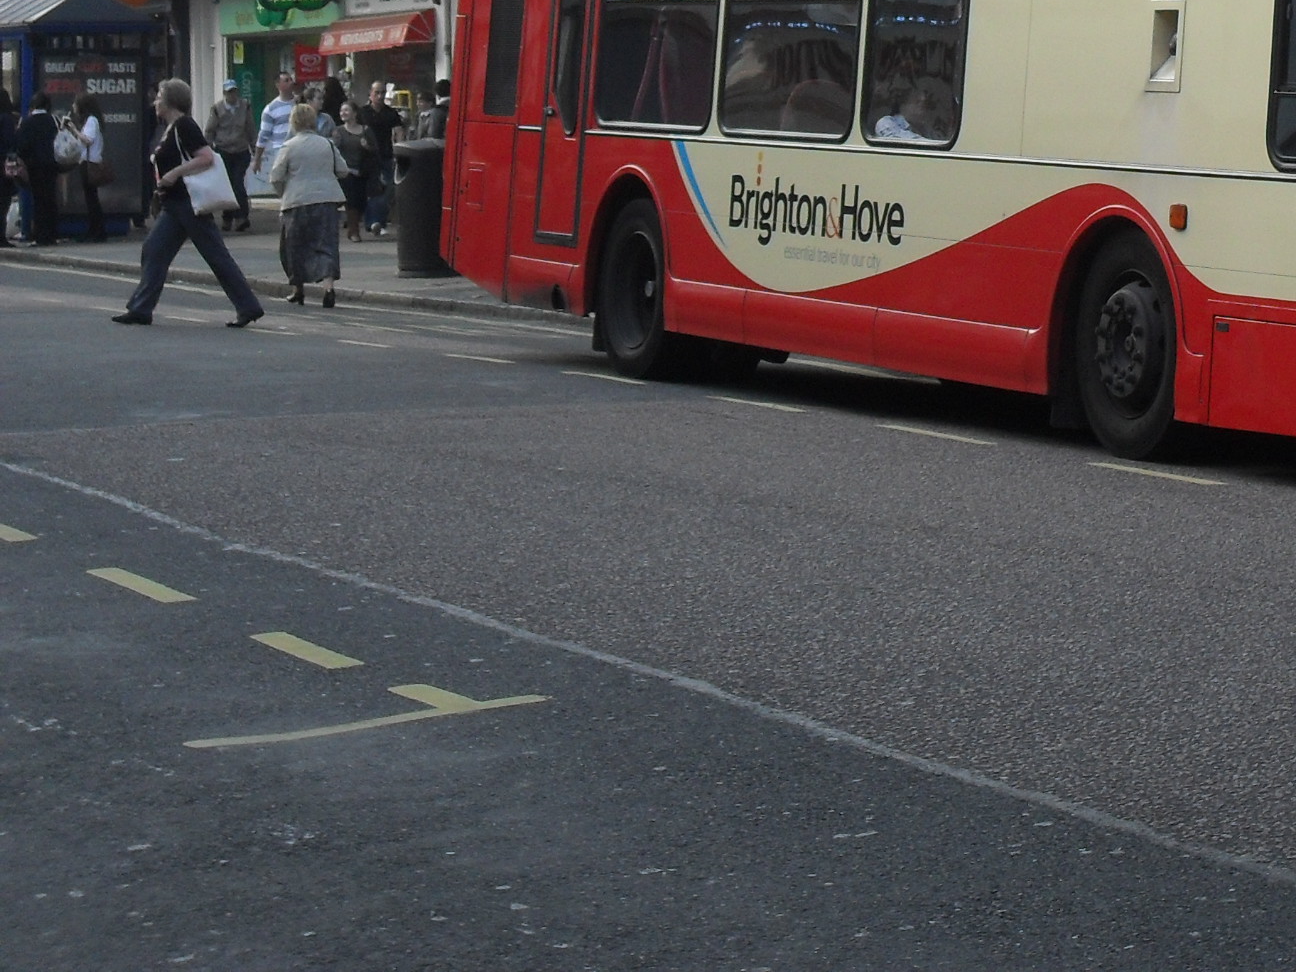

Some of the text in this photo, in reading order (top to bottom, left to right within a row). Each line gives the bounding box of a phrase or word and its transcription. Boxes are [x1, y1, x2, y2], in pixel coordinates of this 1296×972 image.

[44, 62, 75, 73] GREAT
[107, 62, 136, 73] TASTE
[86, 79, 136, 94] SUGAR
